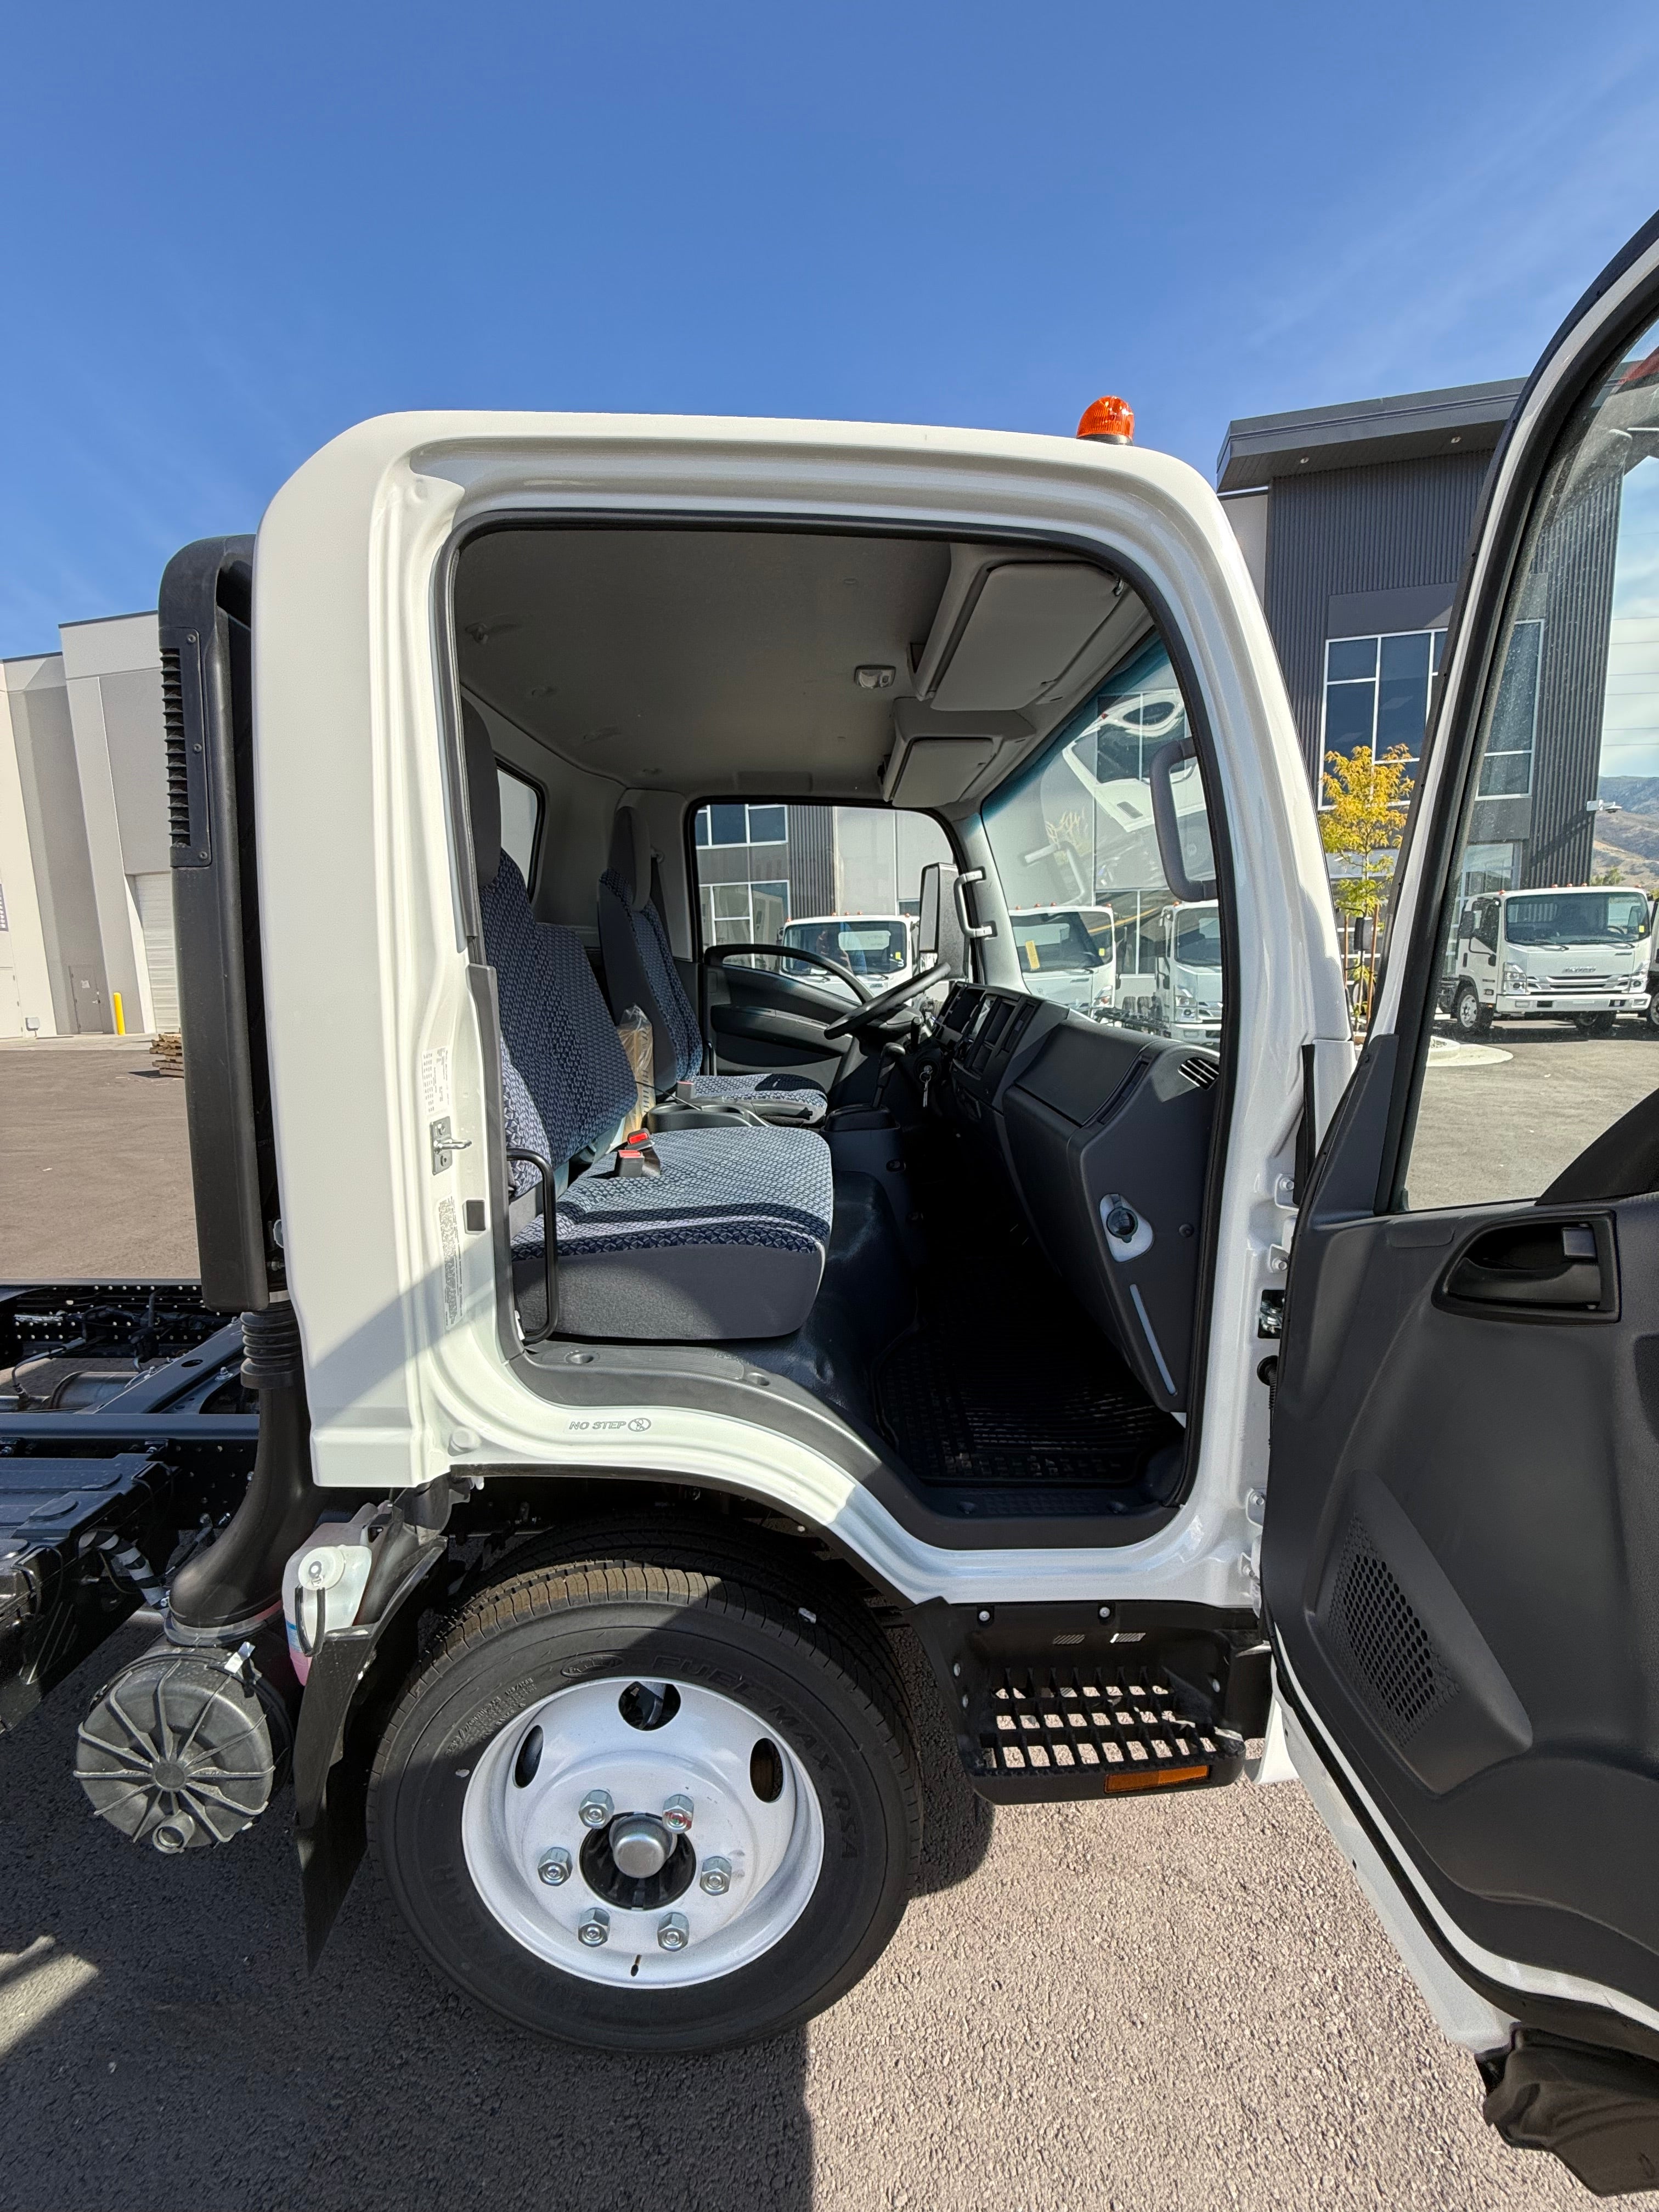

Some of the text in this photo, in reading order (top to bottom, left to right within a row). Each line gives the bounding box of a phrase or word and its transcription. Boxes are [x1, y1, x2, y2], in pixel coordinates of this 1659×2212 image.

[569, 1421, 626, 1430] NO STEP
[652, 1654, 858, 1860] FUEL MAX RSA
